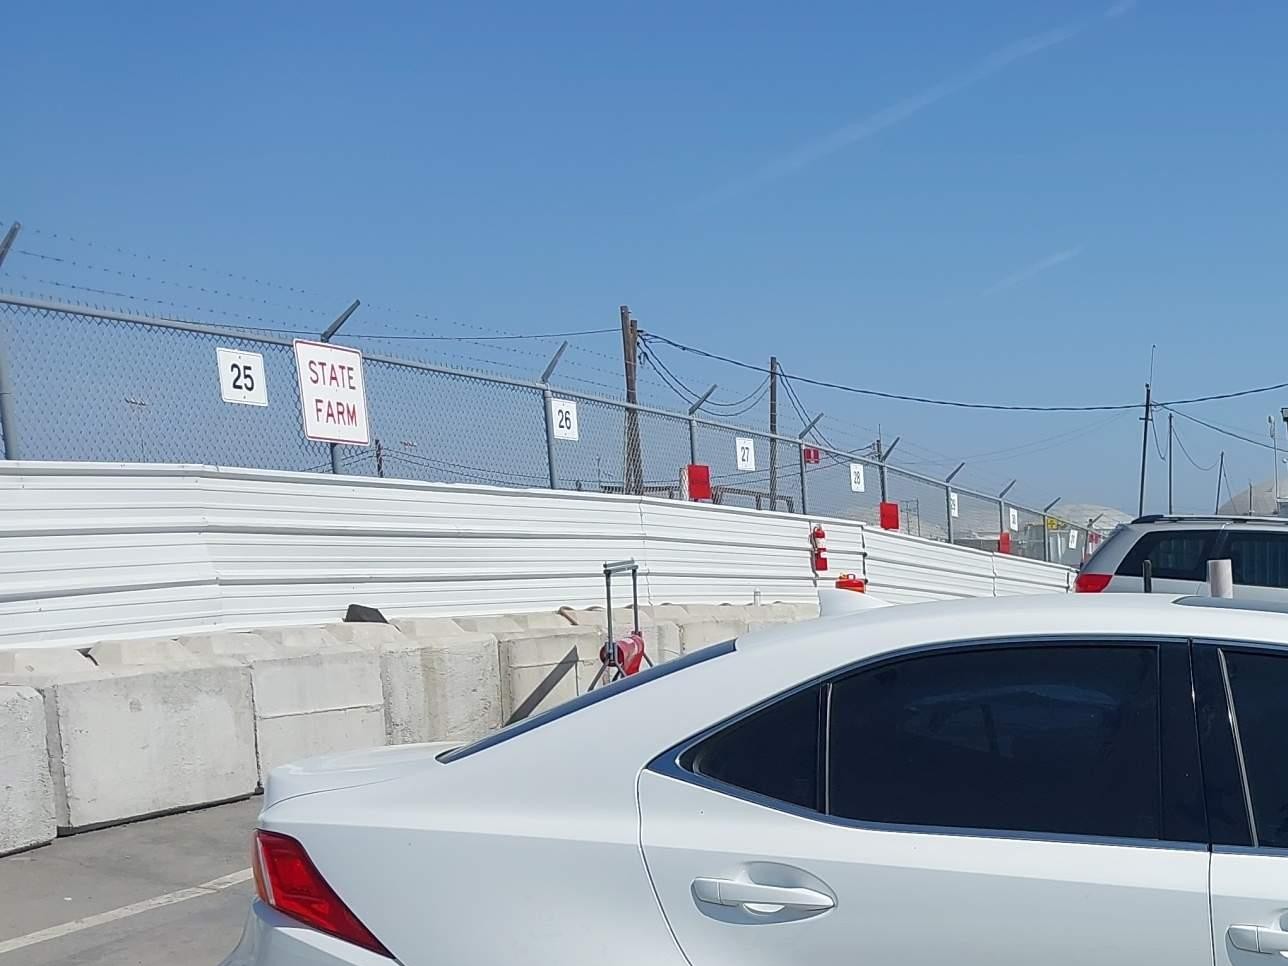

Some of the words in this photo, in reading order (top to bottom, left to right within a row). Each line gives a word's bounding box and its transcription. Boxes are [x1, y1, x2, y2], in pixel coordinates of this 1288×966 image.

[230, 363, 255, 392] 25
[308, 359, 357, 391] STATE
[314, 398, 358, 427] FARM
[557, 409, 572, 430] 26
[740, 446, 750, 463] 27
